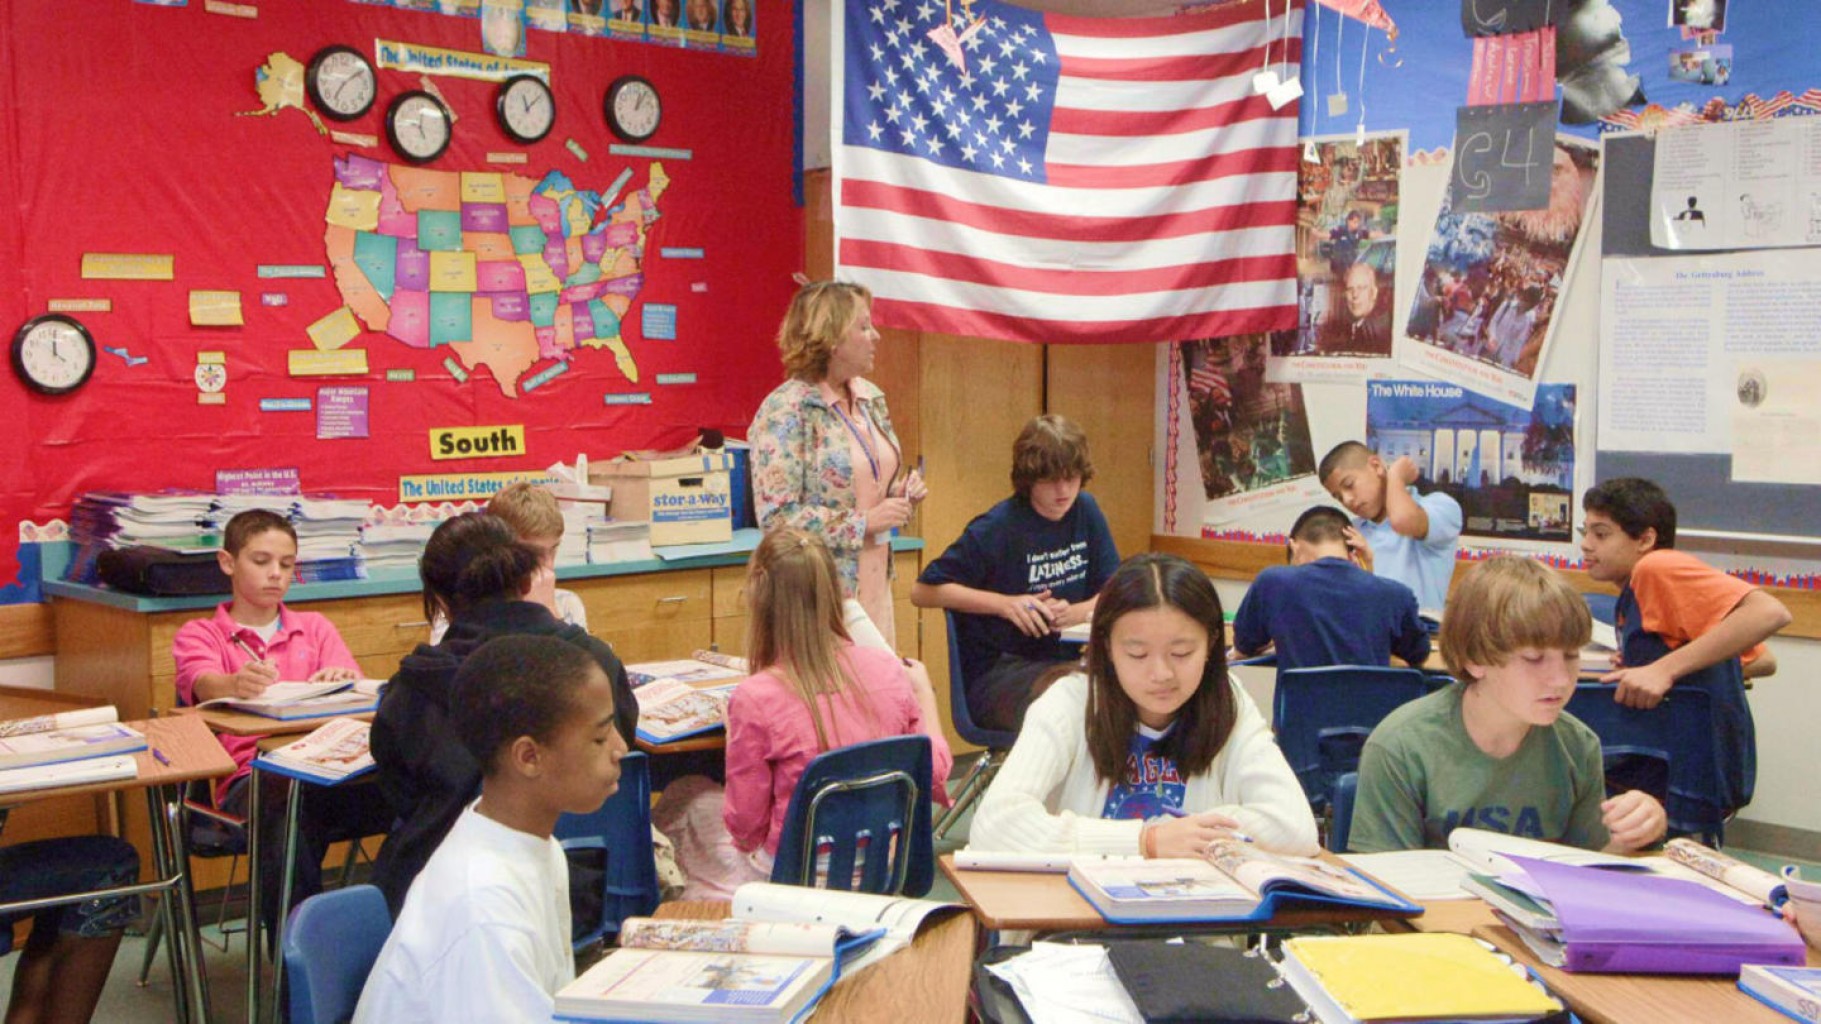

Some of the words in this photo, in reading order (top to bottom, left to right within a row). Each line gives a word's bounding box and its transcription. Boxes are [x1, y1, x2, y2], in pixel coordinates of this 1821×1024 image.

[381, 46, 400, 63] The
[446, 53, 483, 71] States
[1372, 383, 1393, 398] The
[1393, 383, 1425, 398] White
[1425, 383, 1463, 398] House
[440, 428, 517, 455] South
[402, 480, 423, 497] The
[426, 477, 465, 496] United
[468, 478, 502, 494] States
[1126, 752, 1187, 787] AGL
[1442, 805, 1545, 838] USA
